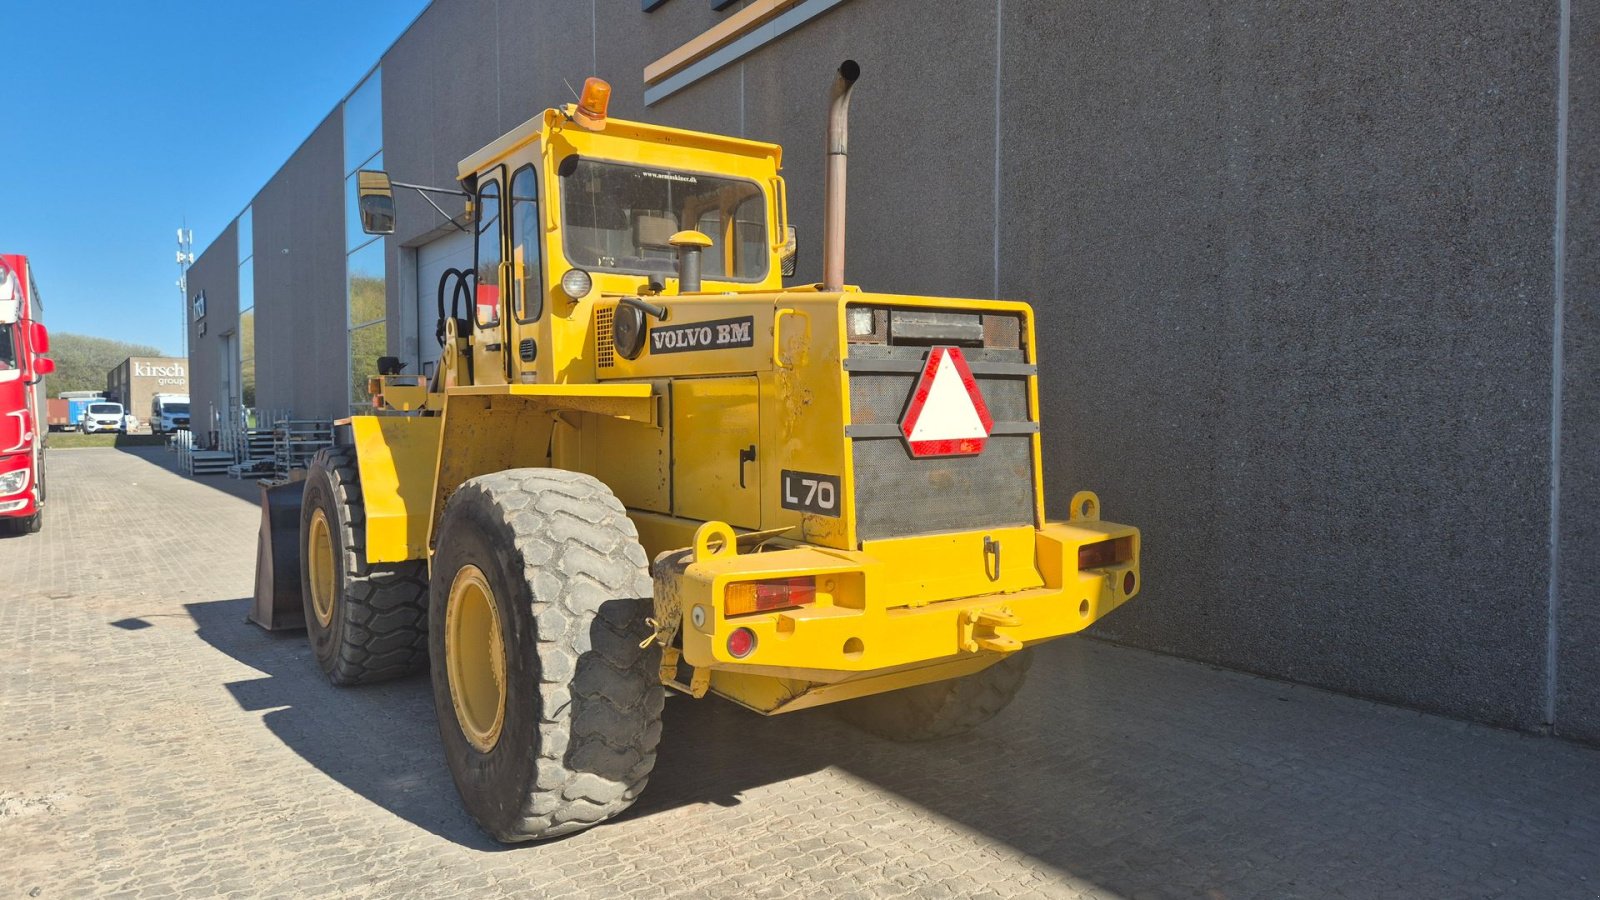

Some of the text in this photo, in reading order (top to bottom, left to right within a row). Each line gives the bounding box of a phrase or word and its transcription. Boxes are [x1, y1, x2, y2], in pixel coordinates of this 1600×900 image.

[652, 322, 751, 349] VOLVO BM
[134, 361, 185, 377] kirsch
[158, 378, 185, 386] group
